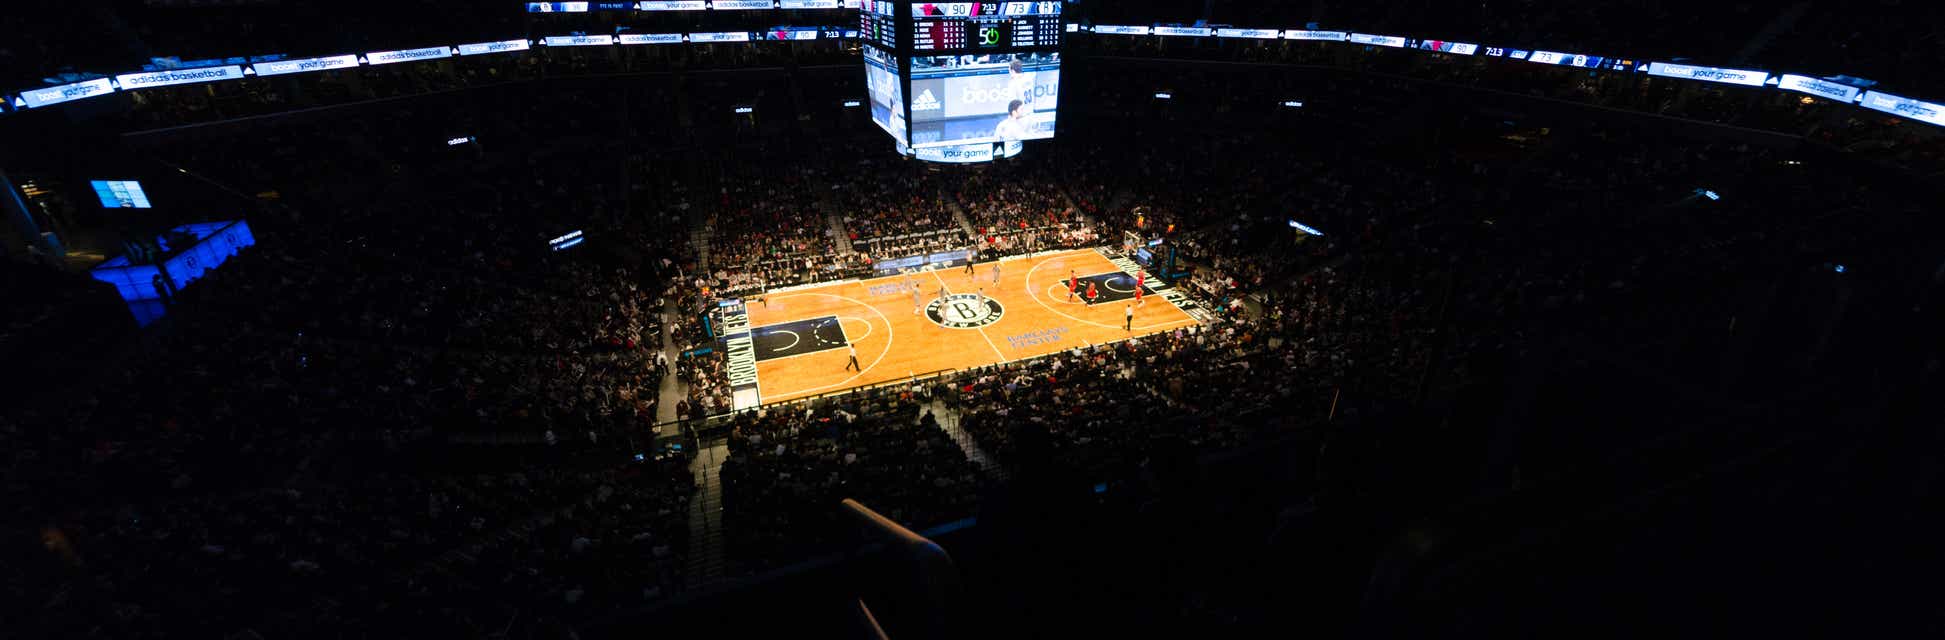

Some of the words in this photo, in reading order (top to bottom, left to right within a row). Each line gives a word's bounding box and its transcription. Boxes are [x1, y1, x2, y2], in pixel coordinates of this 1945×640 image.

[952, 4, 966, 15] 90
[982, 3, 997, 11] 7:13
[1012, 4, 1024, 14] 73
[1486, 47, 1503, 56] 7:13
[130, 72, 170, 85] adidas
[171, 69, 227, 81] basketball
[943, 149, 962, 159] your
[964, 149, 990, 159] game
[953, 302, 977, 320] B
